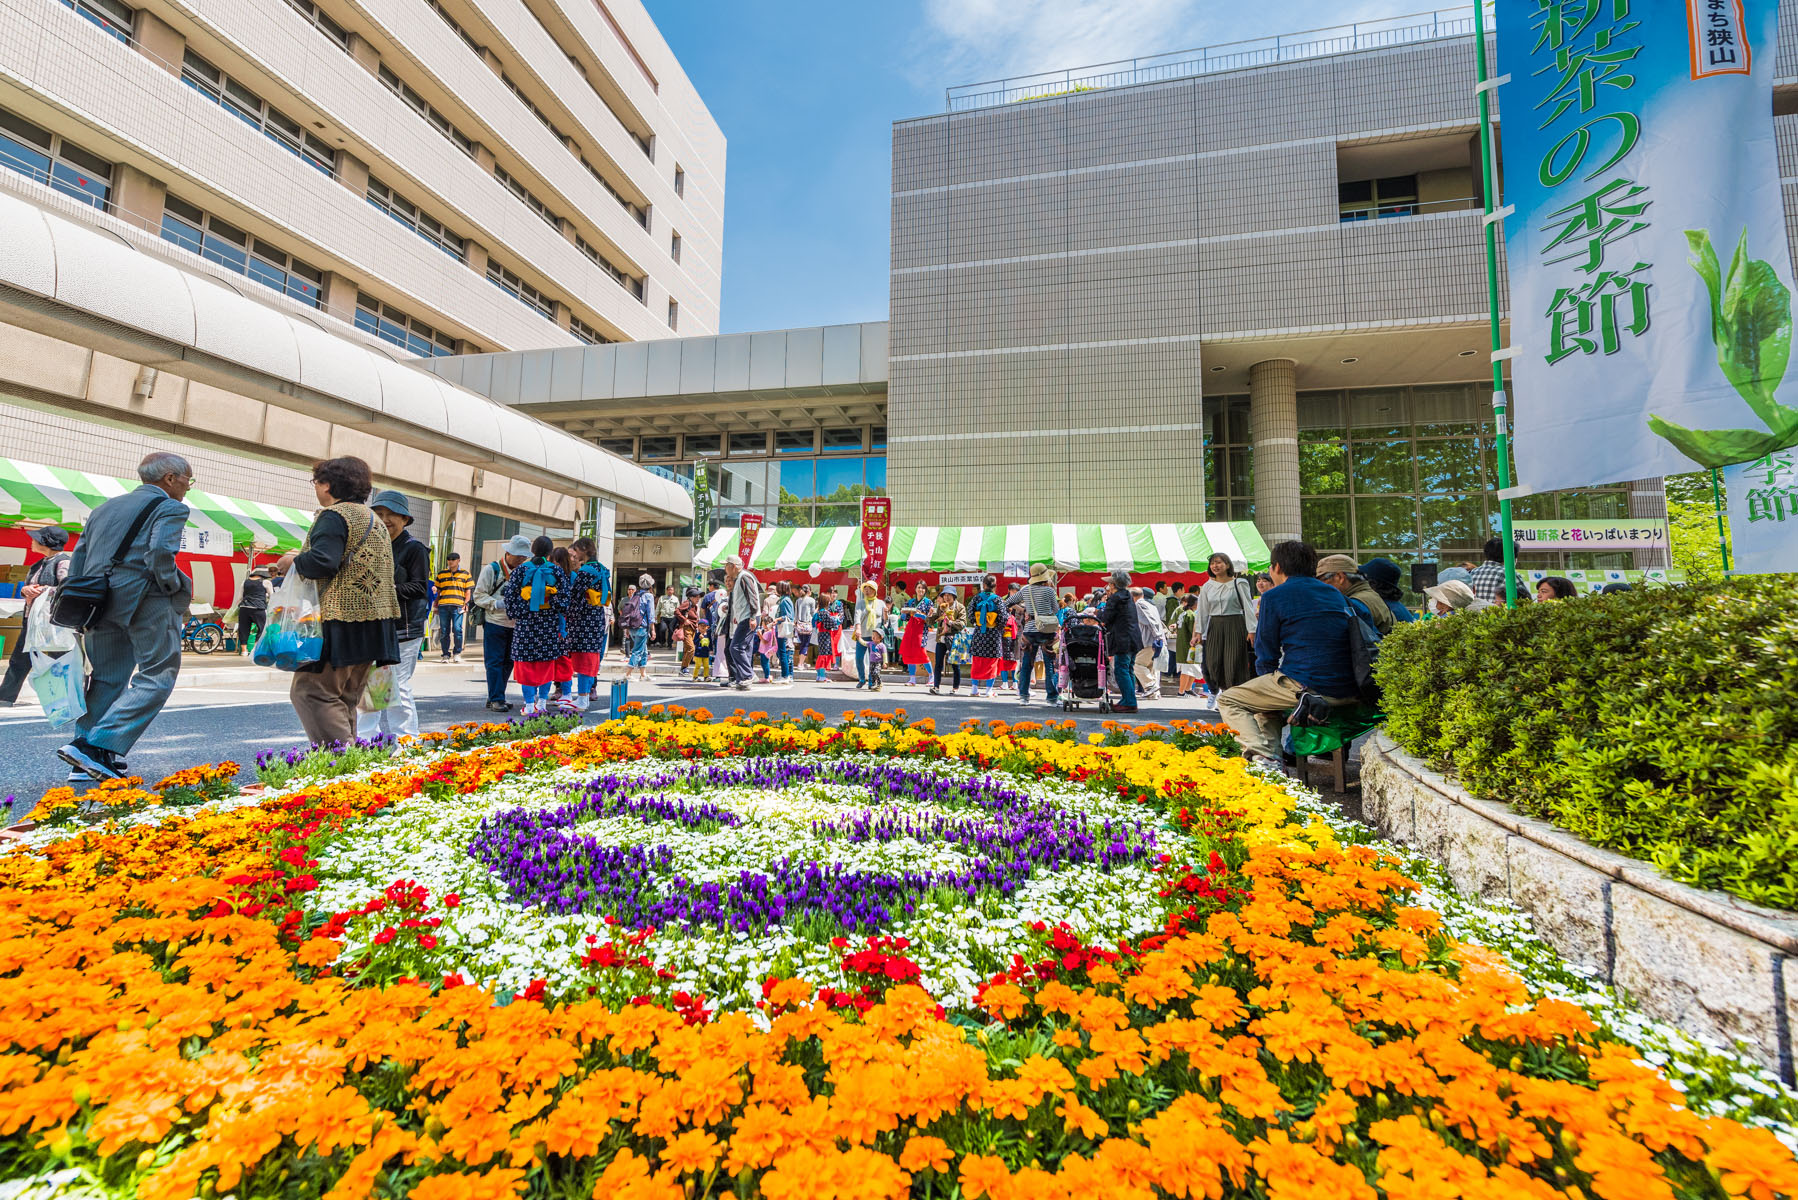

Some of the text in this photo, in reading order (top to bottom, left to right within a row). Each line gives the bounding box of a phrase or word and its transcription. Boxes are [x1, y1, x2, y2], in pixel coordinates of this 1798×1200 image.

[1513, 527, 1663, 542] 狭山新茶と花いっぱいまつり
